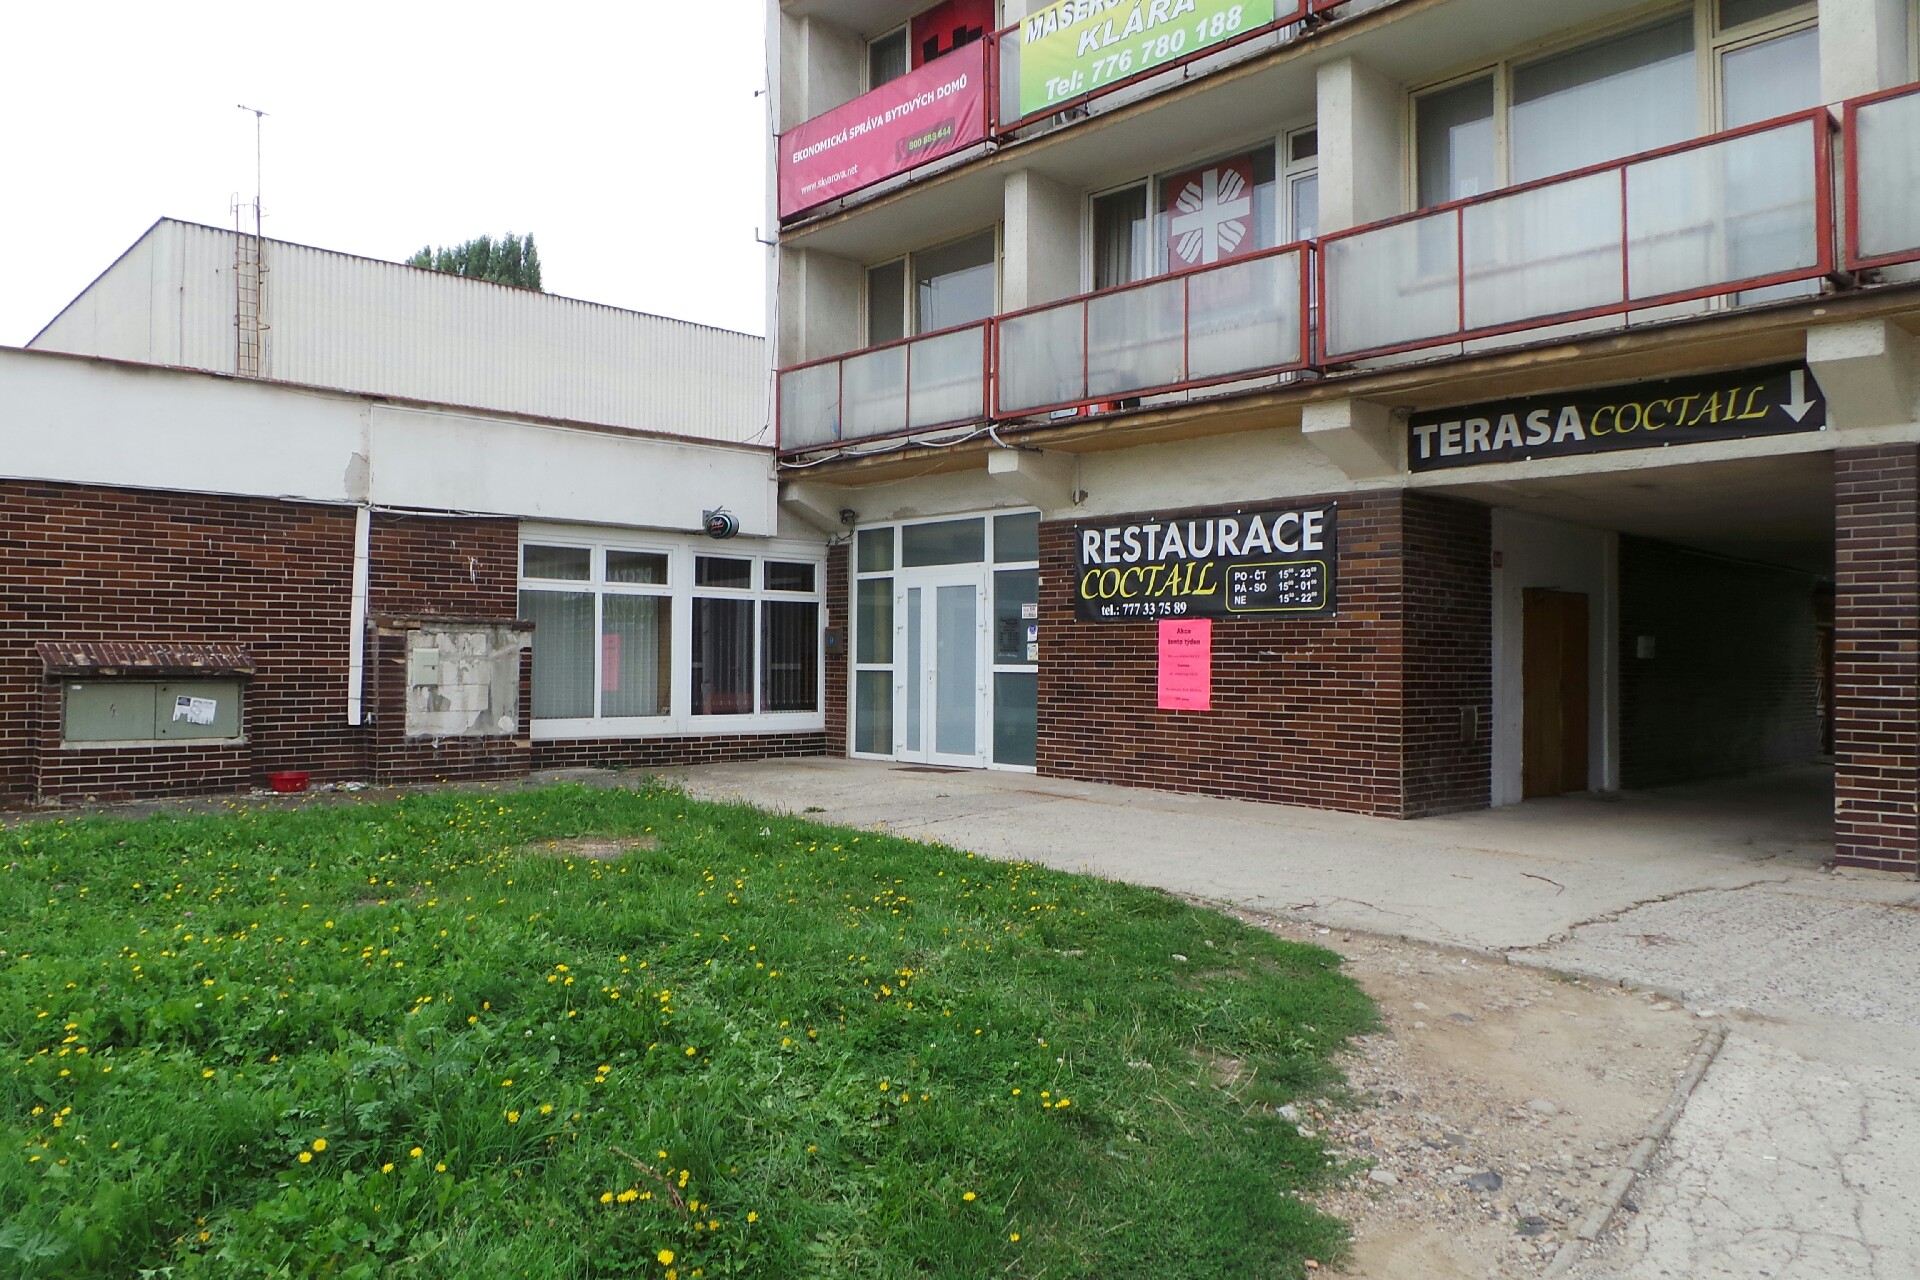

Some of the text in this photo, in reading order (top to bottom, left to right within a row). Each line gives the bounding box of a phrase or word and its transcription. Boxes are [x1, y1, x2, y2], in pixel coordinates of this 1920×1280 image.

[1045, 5, 1243, 101] Tel: 776 780 188
[792, 73, 968, 164] EKONOMICKÁ SPRÁVA BYTOVÝCH DOMŮ
[1413, 385, 1770, 460] TERASA COCTAIL
[1082, 510, 1325, 565] RESTAURACE
[1081, 562, 1218, 600] COCTAIL
[1234, 571, 1248, 581] PO
[1254, 569, 1267, 581] ČT
[1234, 582, 1248, 593] PÁ
[1254, 582, 1267, 593] SO
[1101, 600, 1187, 617] tel.: 777 33 75 89
[1234, 595, 1247, 605] NE
[1176, 627, 1192, 635] Akce
